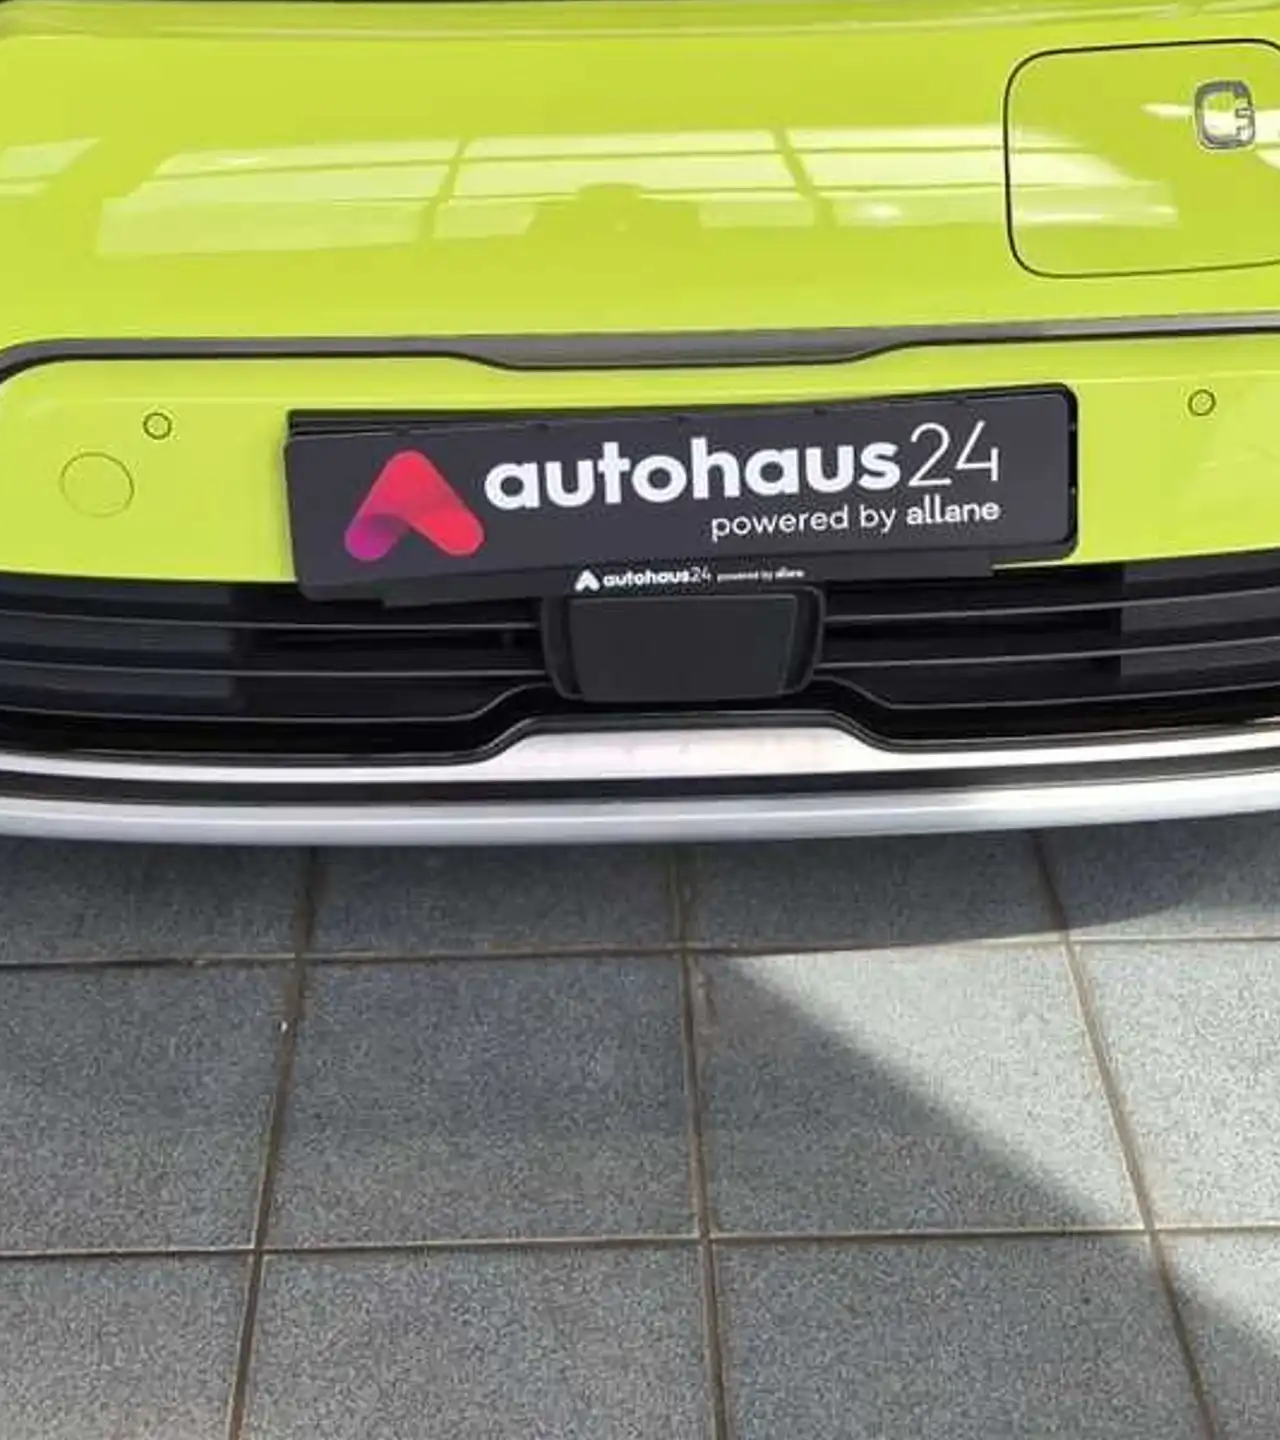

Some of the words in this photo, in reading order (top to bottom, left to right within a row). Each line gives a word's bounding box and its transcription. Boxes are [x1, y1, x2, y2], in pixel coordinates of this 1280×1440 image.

[483, 420, 1000, 510] autohaus24
[711, 504, 849, 543] powered
[859, 503, 896, 533] by
[906, 494, 1000, 526] allane
[602, 566, 711, 588] autohaus24
